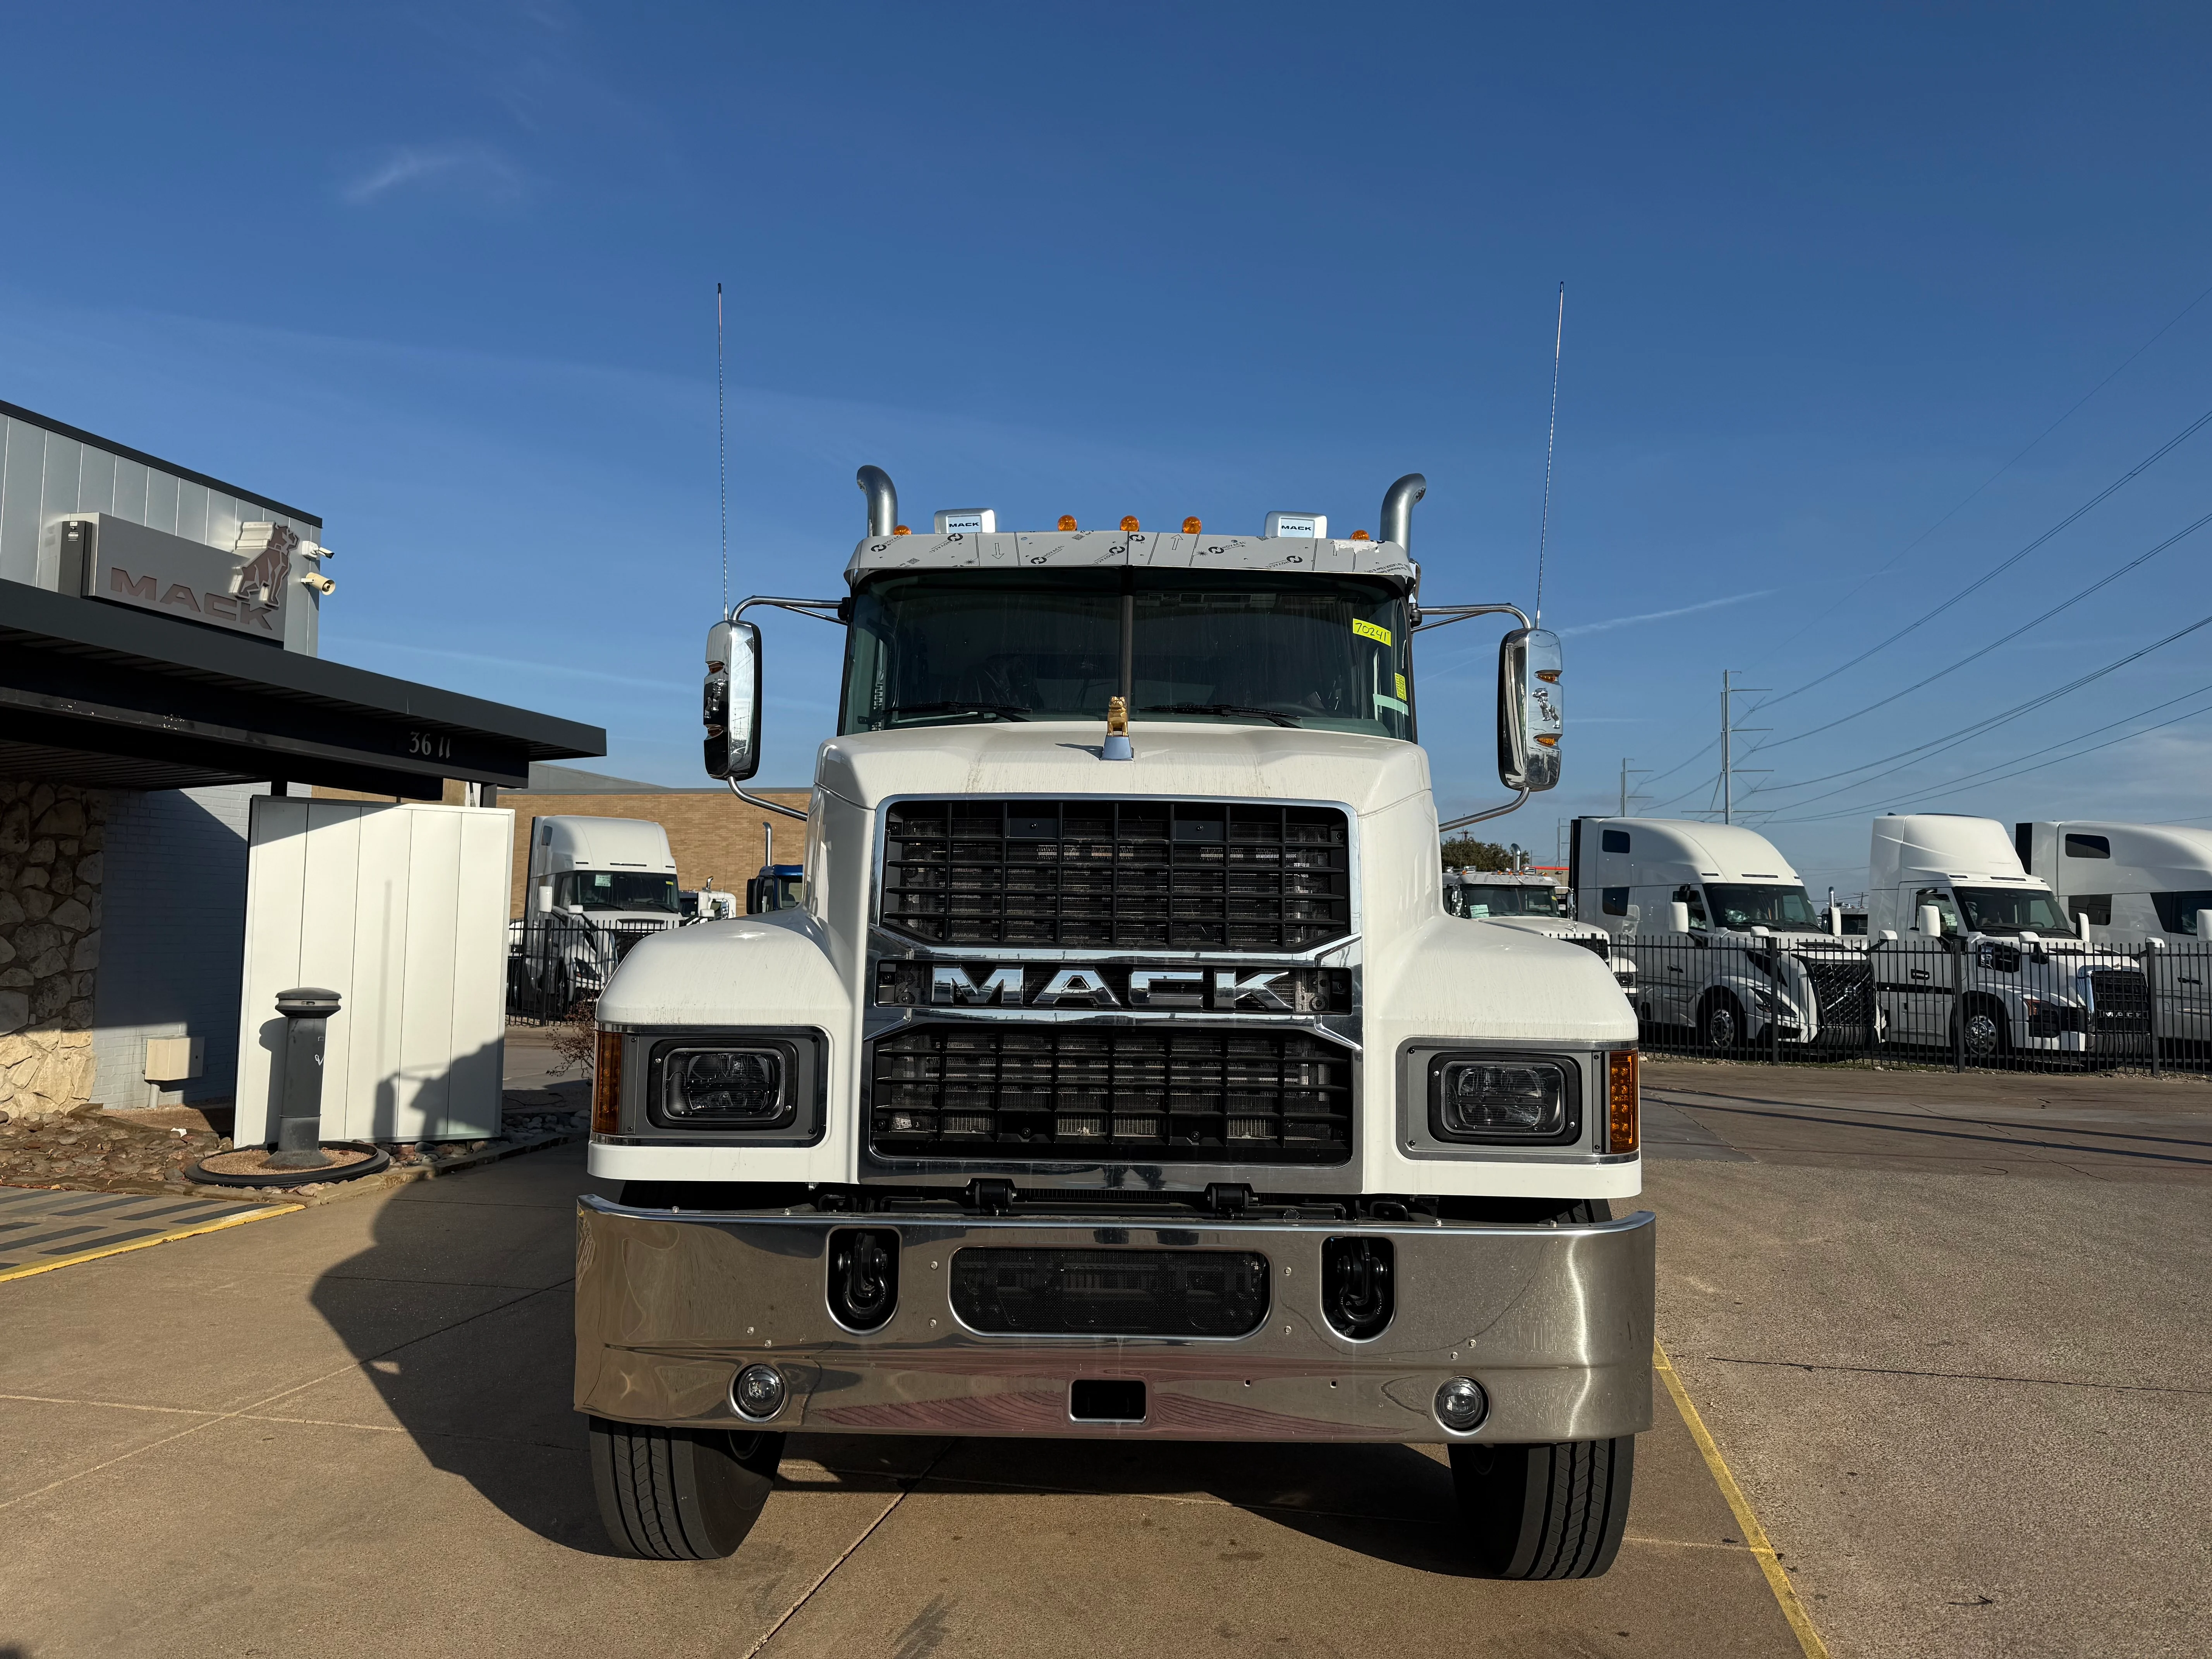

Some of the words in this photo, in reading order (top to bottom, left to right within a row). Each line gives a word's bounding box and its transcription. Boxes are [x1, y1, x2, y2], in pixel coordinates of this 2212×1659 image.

[110, 567, 273, 631] MACK
[1355, 623, 1386, 641] 70241
[931, 964, 1294, 1010] MACK
